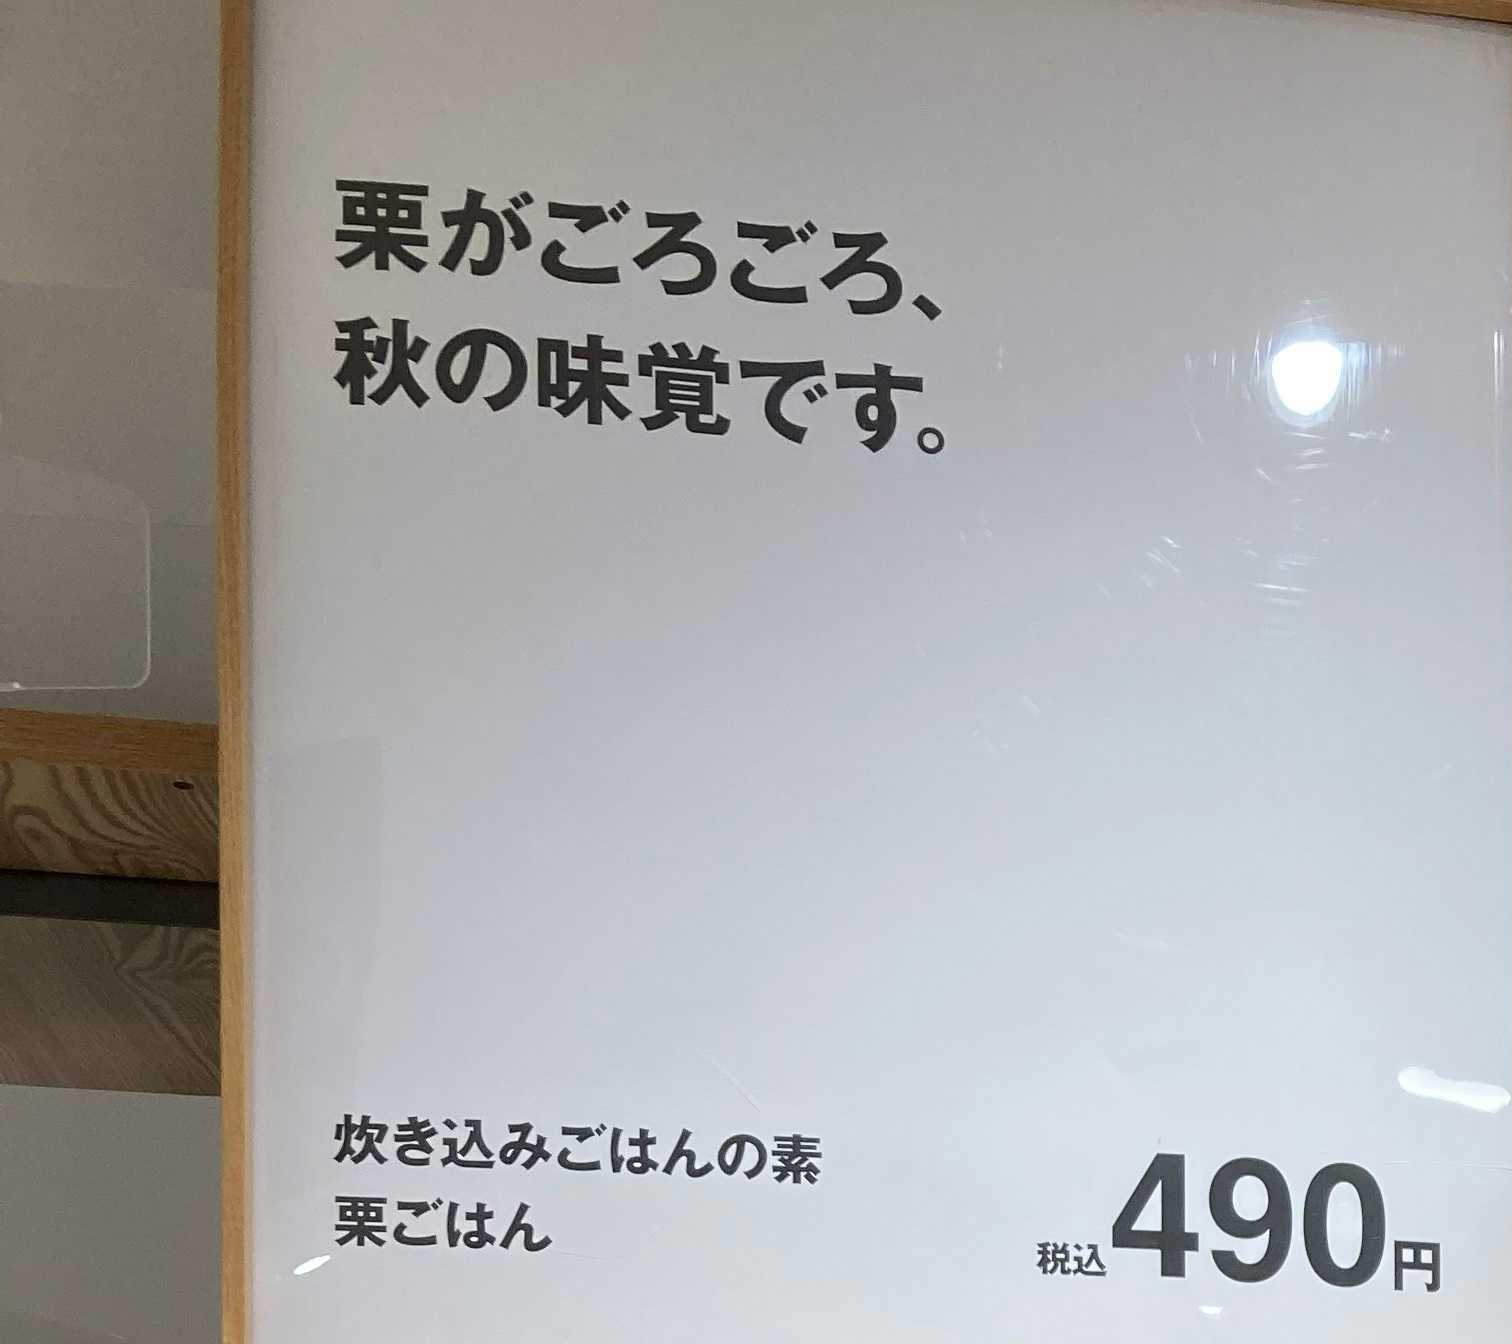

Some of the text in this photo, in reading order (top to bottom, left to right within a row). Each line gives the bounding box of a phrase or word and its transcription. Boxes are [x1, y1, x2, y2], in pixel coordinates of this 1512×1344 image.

[336, 177, 942, 321] 栗がごろごろ、
[334, 317, 946, 457] 秋の味覚です。
[332, 1113, 824, 1185] 炊き込みごはんの素
[332, 1194, 552, 1253] 栗ごはん
